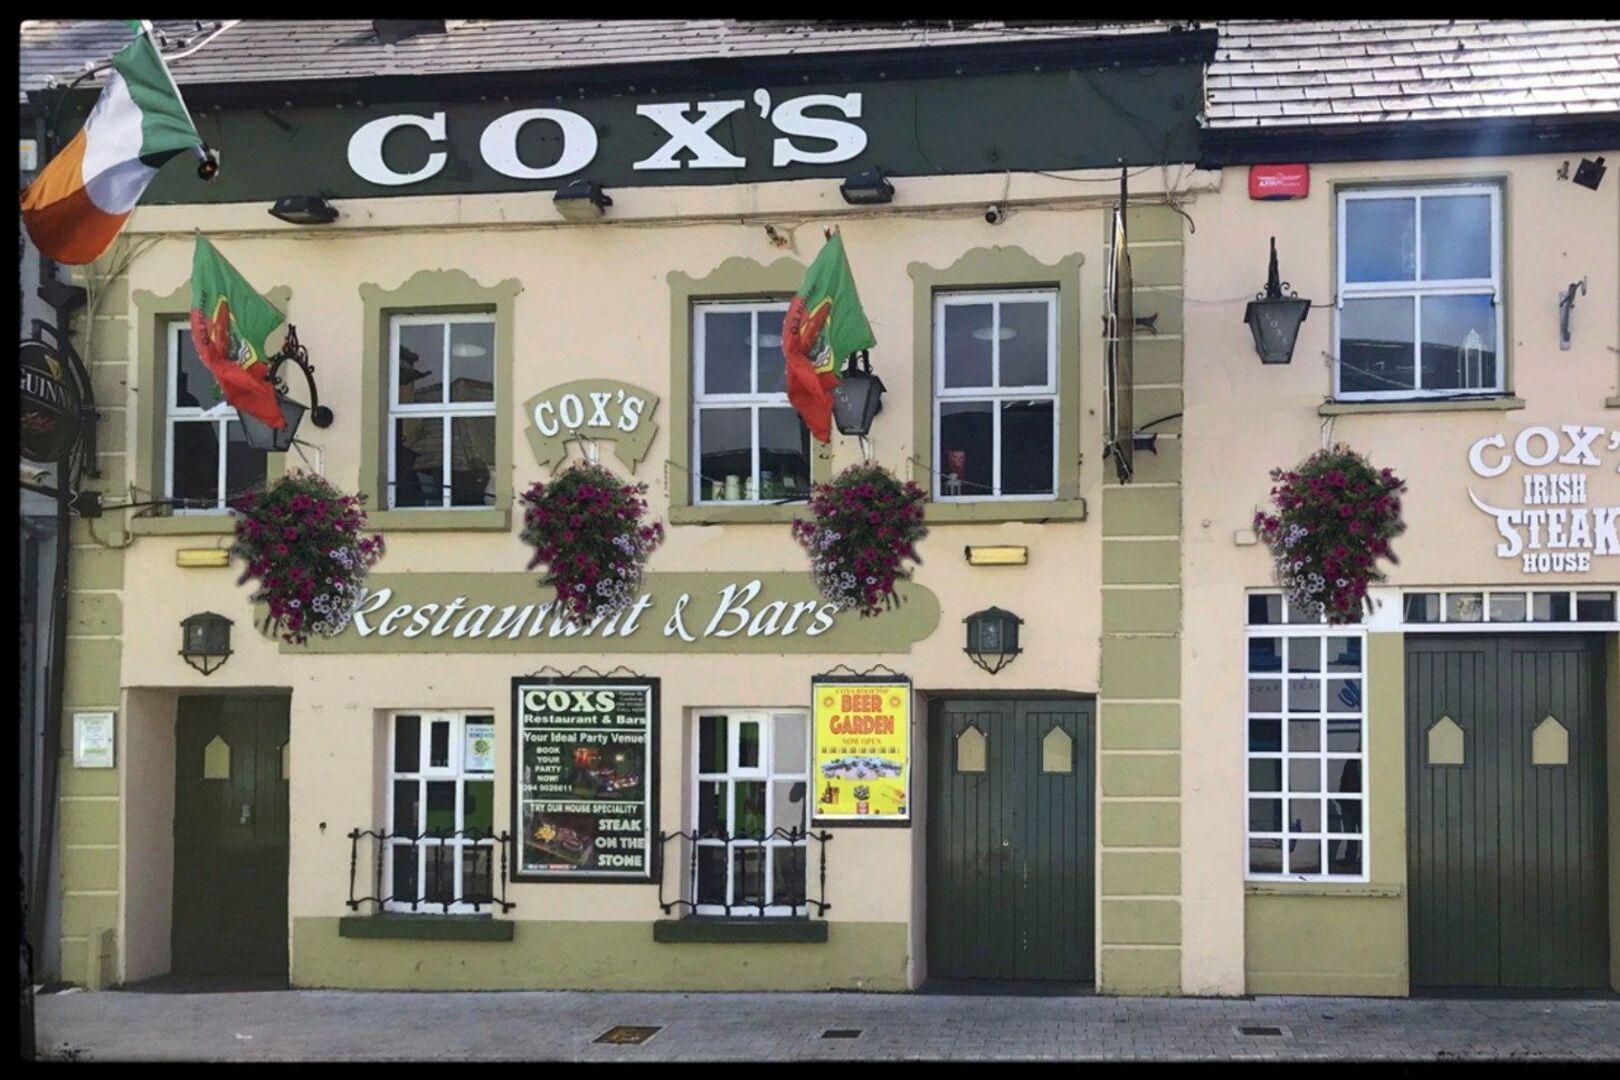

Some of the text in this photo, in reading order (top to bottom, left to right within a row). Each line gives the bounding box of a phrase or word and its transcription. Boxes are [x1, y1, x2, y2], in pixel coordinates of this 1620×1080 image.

[347, 87, 868, 186] COX'S
[535, 388, 645, 437] COX'S
[1524, 473, 1587, 505] IRISH
[1497, 507, 1620, 557] STEAK
[1523, 551, 1590, 573] HOUSE
[663, 593, 696, 642] &
[702, 579, 841, 637] Bars
[524, 690, 616, 712] COXS
[841, 694, 883, 713] BEER
[524, 714, 647, 725] Restaurant & Bars
[829, 715, 895, 735] GARDEN
[523, 732, 548, 742] Your
[550, 732, 578, 742] Ideal
[580, 732, 609, 745] Party
[536, 746, 561, 754] BOOK
[535, 765, 562, 773] PARTY
[530, 803, 638, 815] TRY OUR HOUSE SPECIALITY
[598, 818, 642, 831] STEAK
[594, 836, 646, 849] ON THE
[597, 853, 642, 867] STONE
